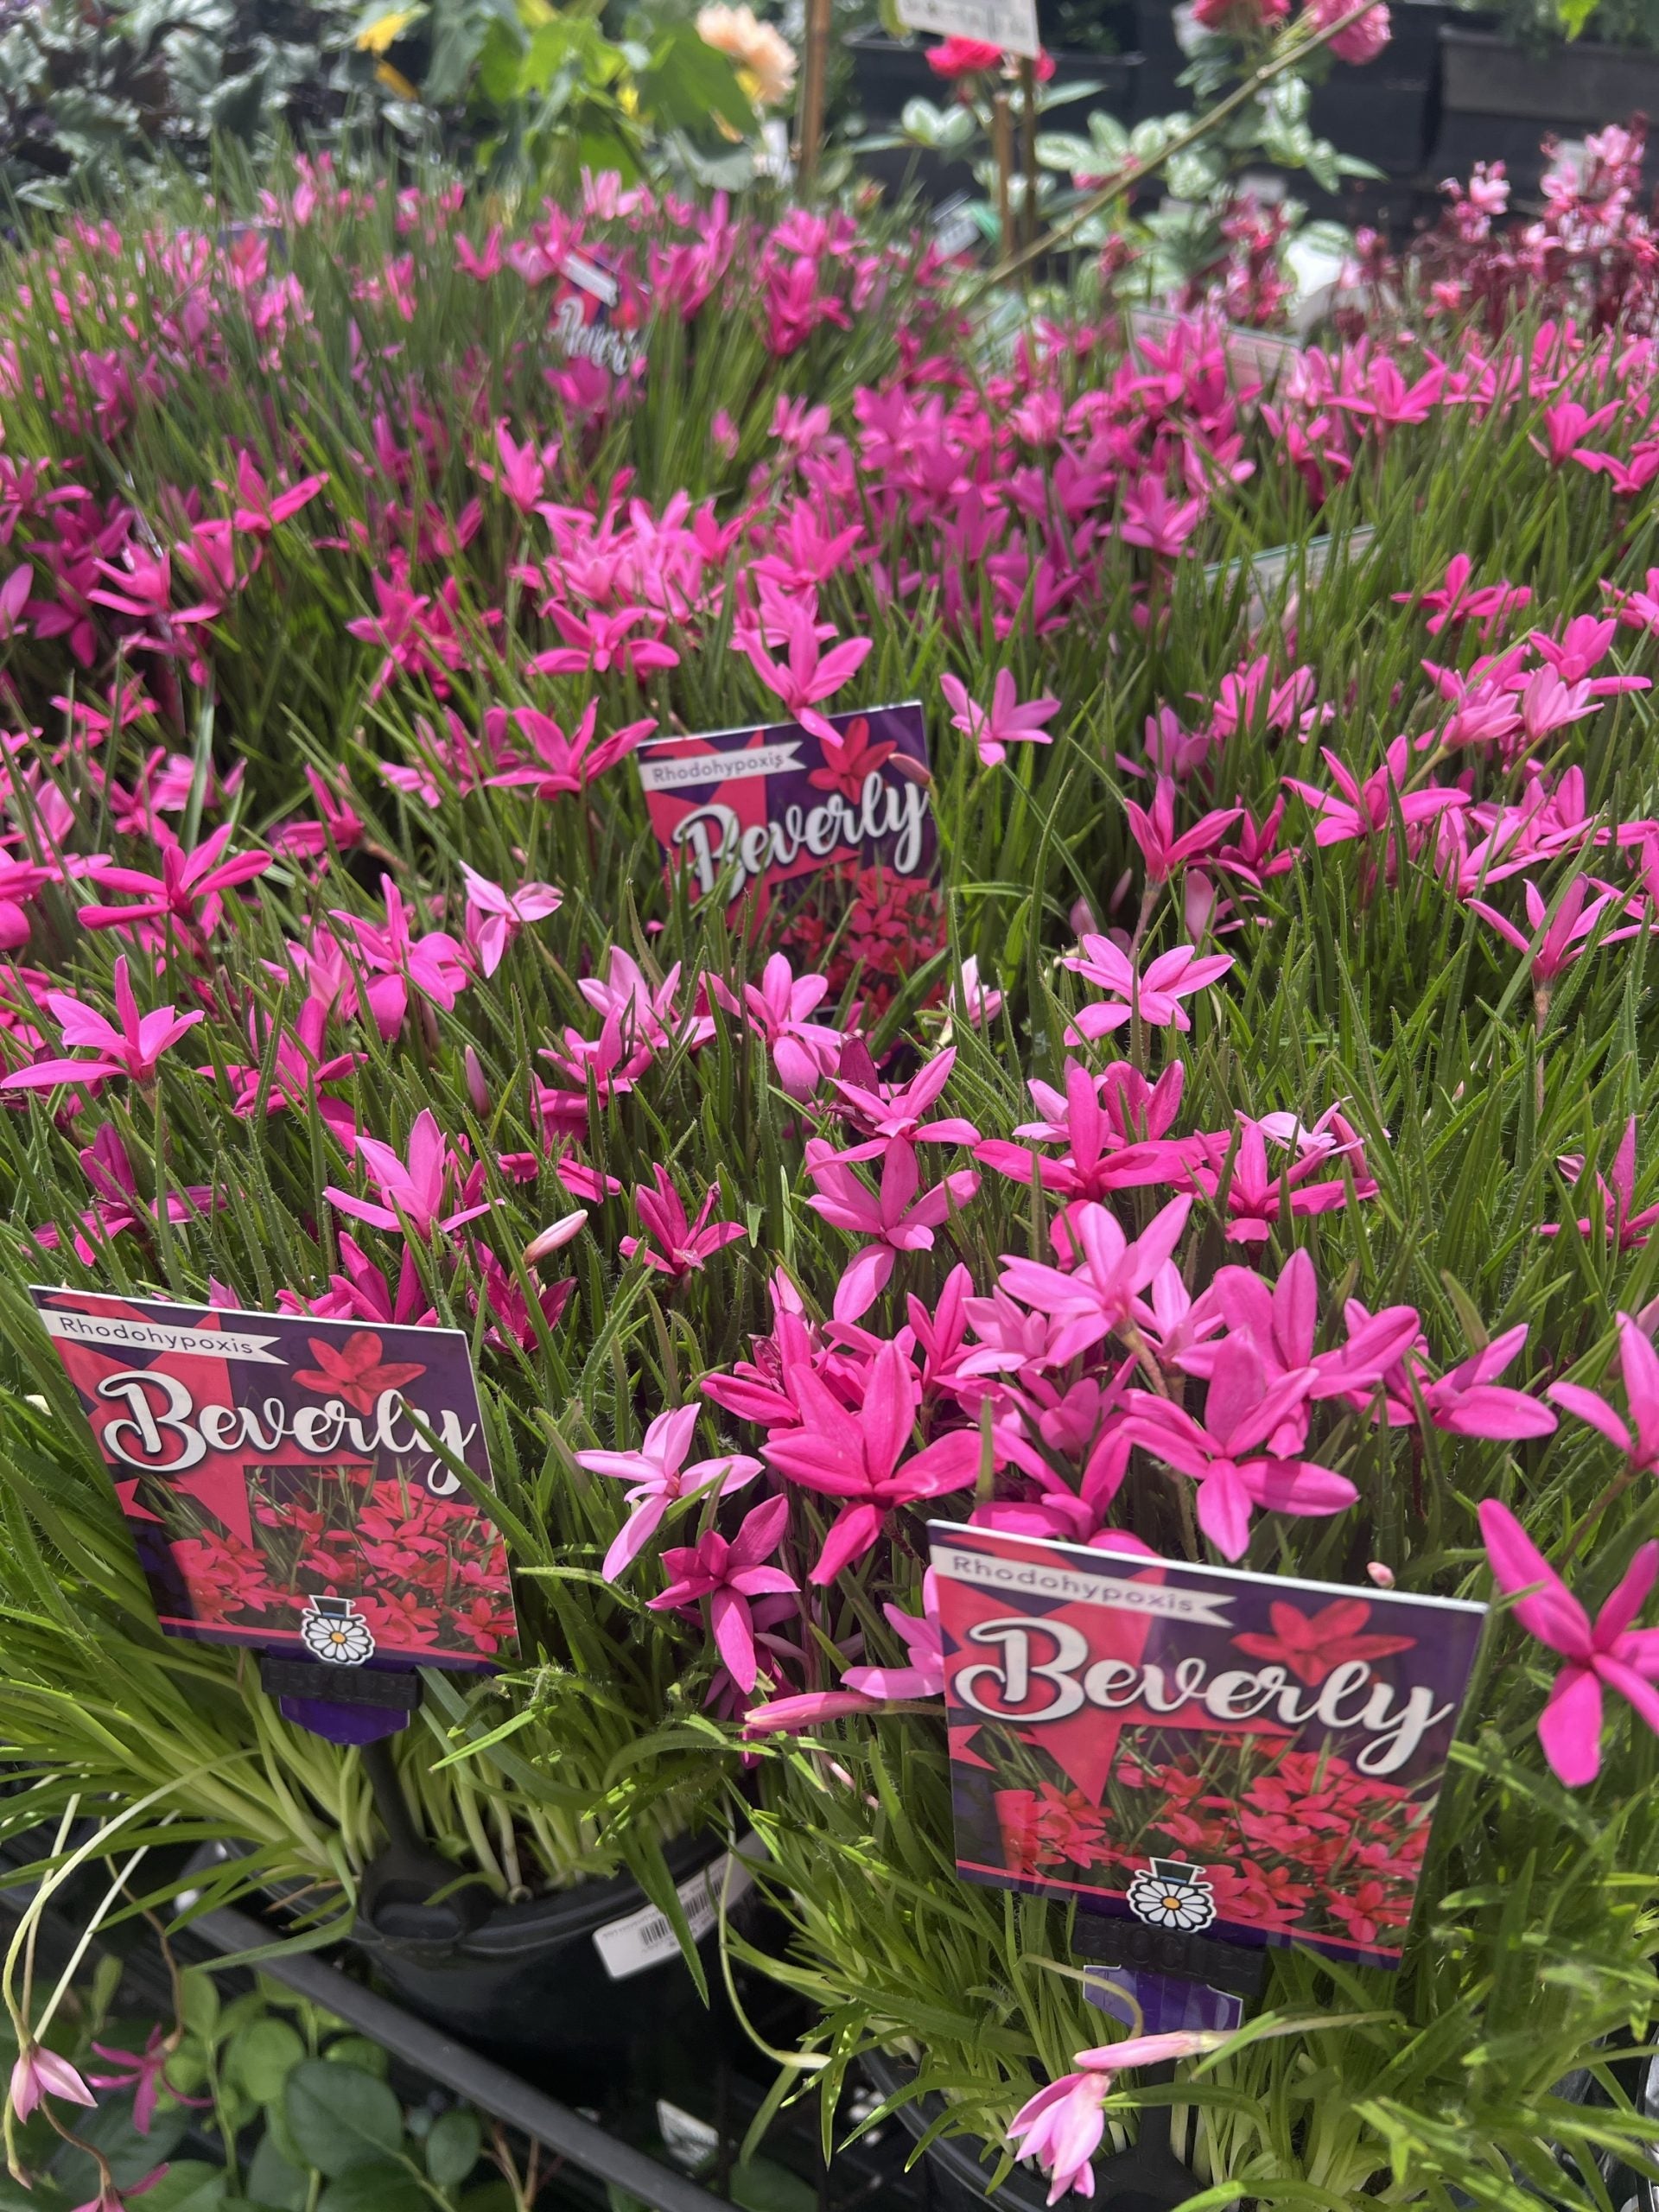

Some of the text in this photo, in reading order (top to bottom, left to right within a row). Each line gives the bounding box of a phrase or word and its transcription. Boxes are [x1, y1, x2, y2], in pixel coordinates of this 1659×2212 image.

[652, 753, 785, 784] Rhodohypoxis
[672, 771, 929, 907] Beverly
[60, 1316, 254, 1356] Rhodohypoxis
[98, 1370, 477, 1496] Beverly
[951, 1554, 1194, 1613] Rhodohypoxis
[954, 1617, 1455, 1776] Beverly
